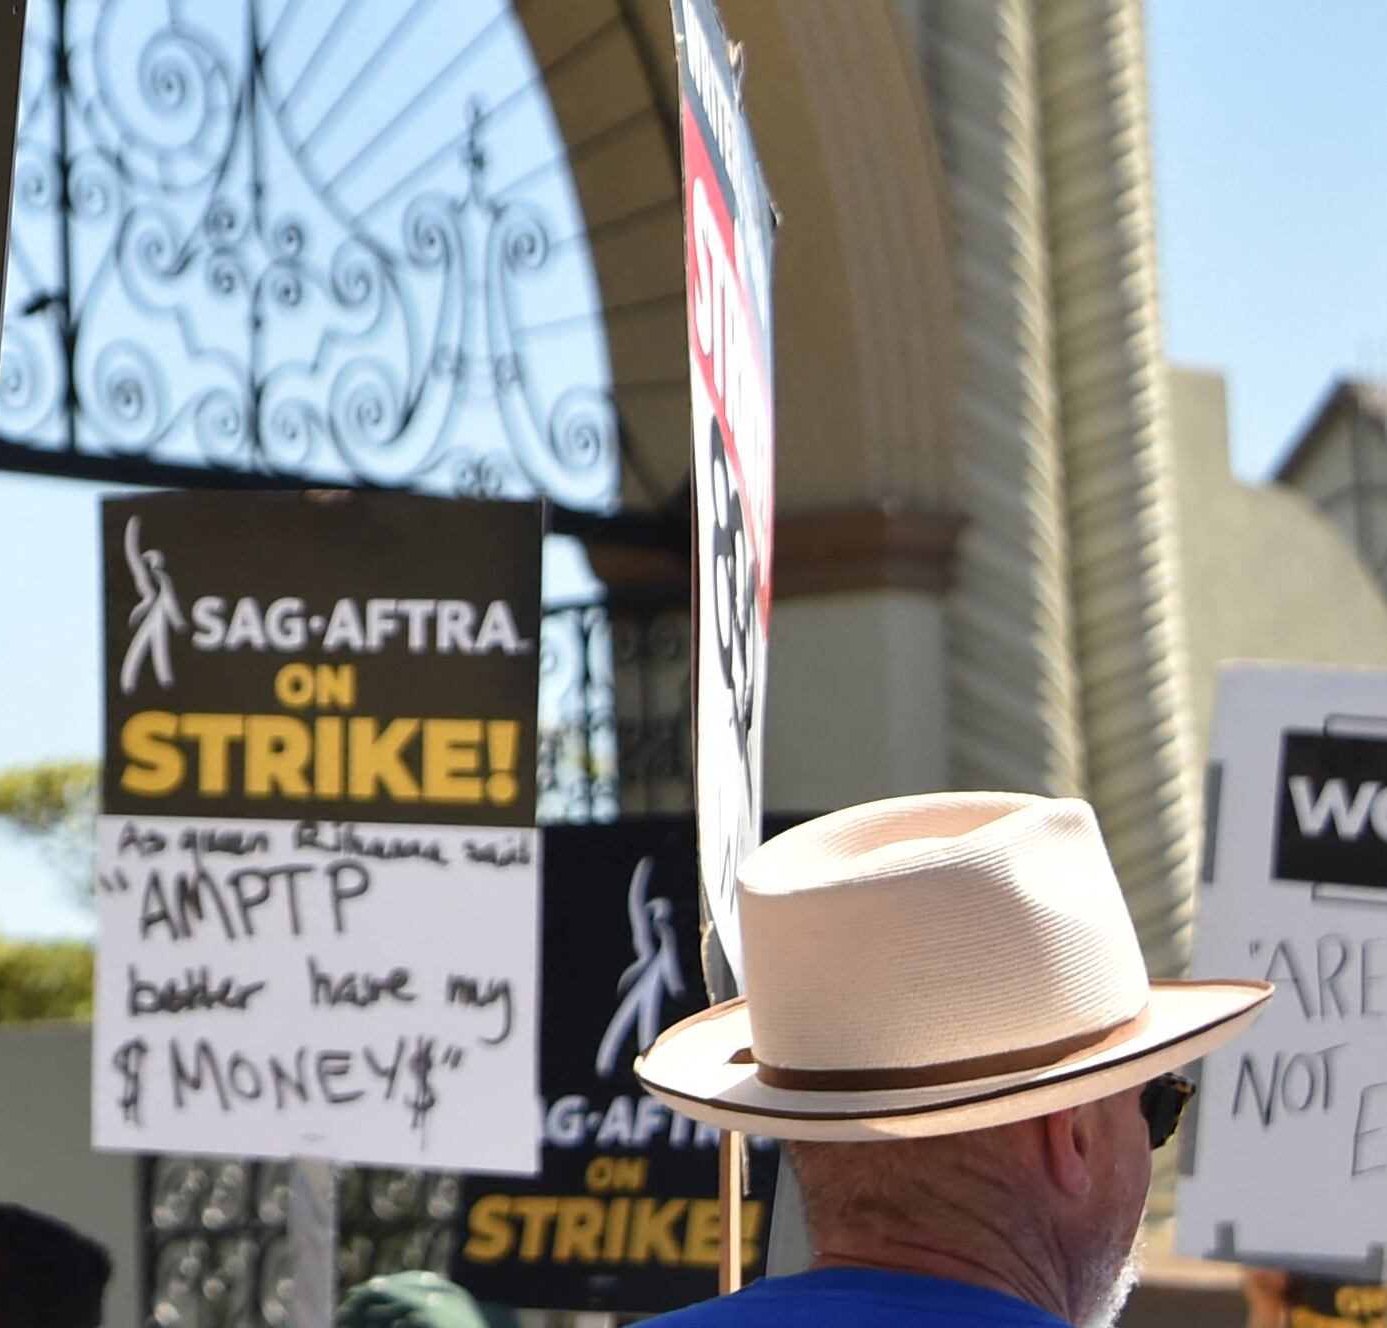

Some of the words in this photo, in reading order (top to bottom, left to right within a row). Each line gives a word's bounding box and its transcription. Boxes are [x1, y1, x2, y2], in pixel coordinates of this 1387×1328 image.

[273, 661, 359, 711] ON
[120, 708, 522, 807] STRIKE!
[127, 964, 265, 1017] better
[306, 955, 417, 1007] have
[446, 972, 513, 1045] my
[1231, 1042, 1349, 1128] NOT
[584, 1156, 650, 1194] ON
[463, 1194, 766, 1267] STRIKE!
